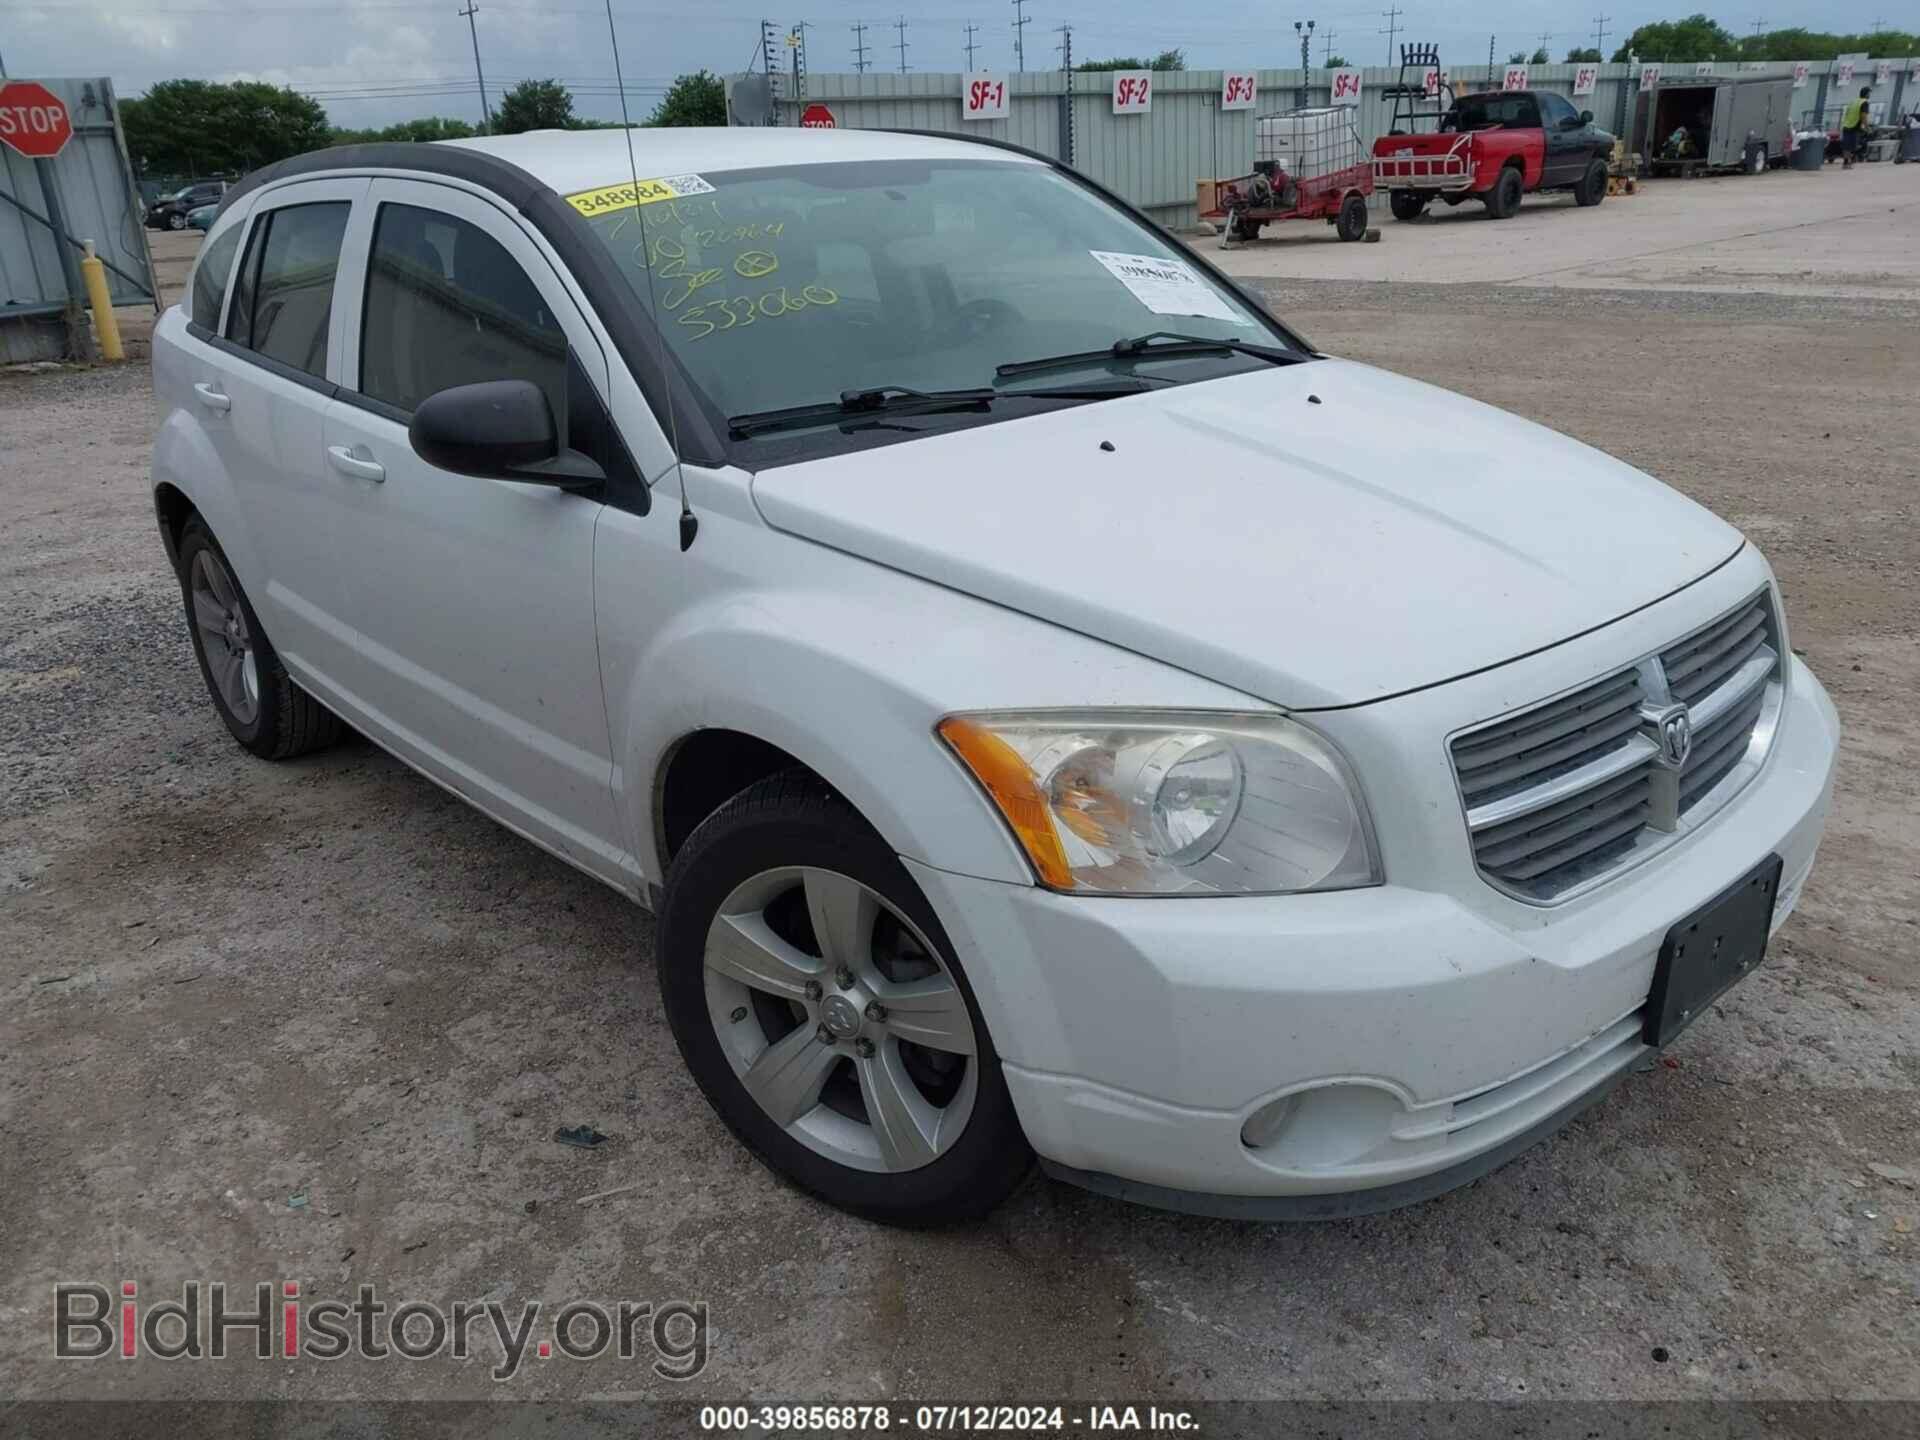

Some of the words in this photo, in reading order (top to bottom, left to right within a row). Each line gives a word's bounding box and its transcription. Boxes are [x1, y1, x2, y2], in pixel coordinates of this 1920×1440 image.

[969, 81, 1004, 110] SF-1
[1117, 78, 1149, 106] SF-2
[1226, 77, 1254, 103] SF-3
[1335, 74, 1360, 97] SF-4
[0, 105, 64, 134] STOP
[575, 183, 669, 212] 348884
